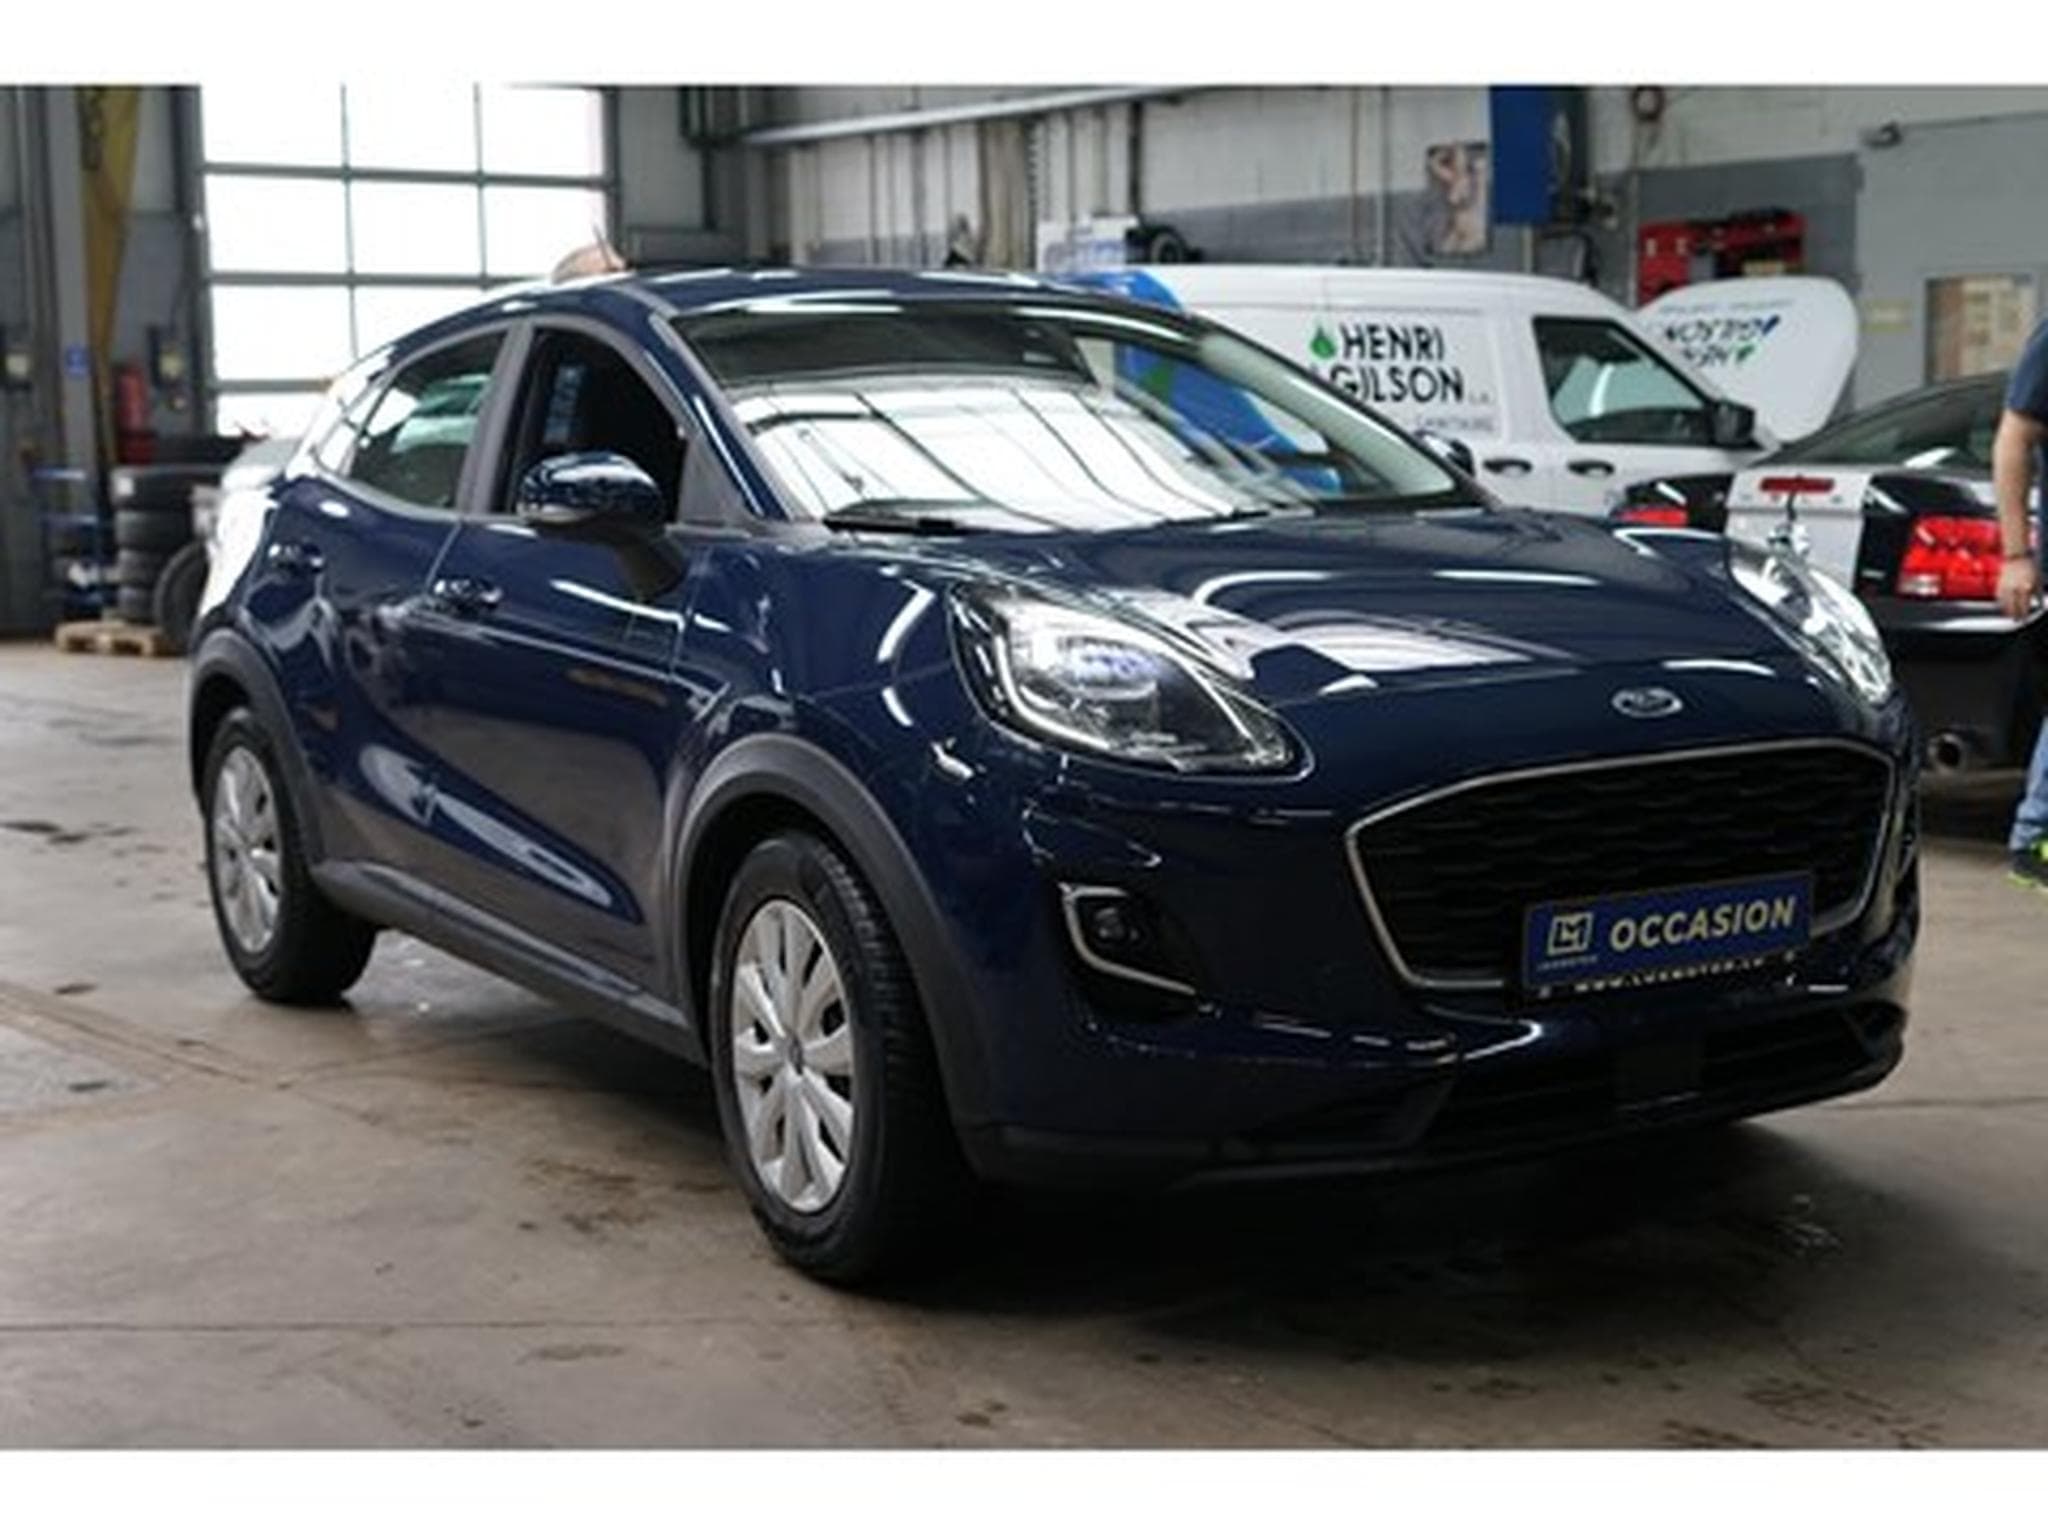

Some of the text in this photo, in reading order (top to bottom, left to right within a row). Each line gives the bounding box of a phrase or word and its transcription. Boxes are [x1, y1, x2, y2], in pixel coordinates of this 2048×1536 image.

[1340, 323, 1445, 361] HENRI
[1330, 365, 1464, 402] GILSON
[1610, 896, 1796, 950] OCCASION
